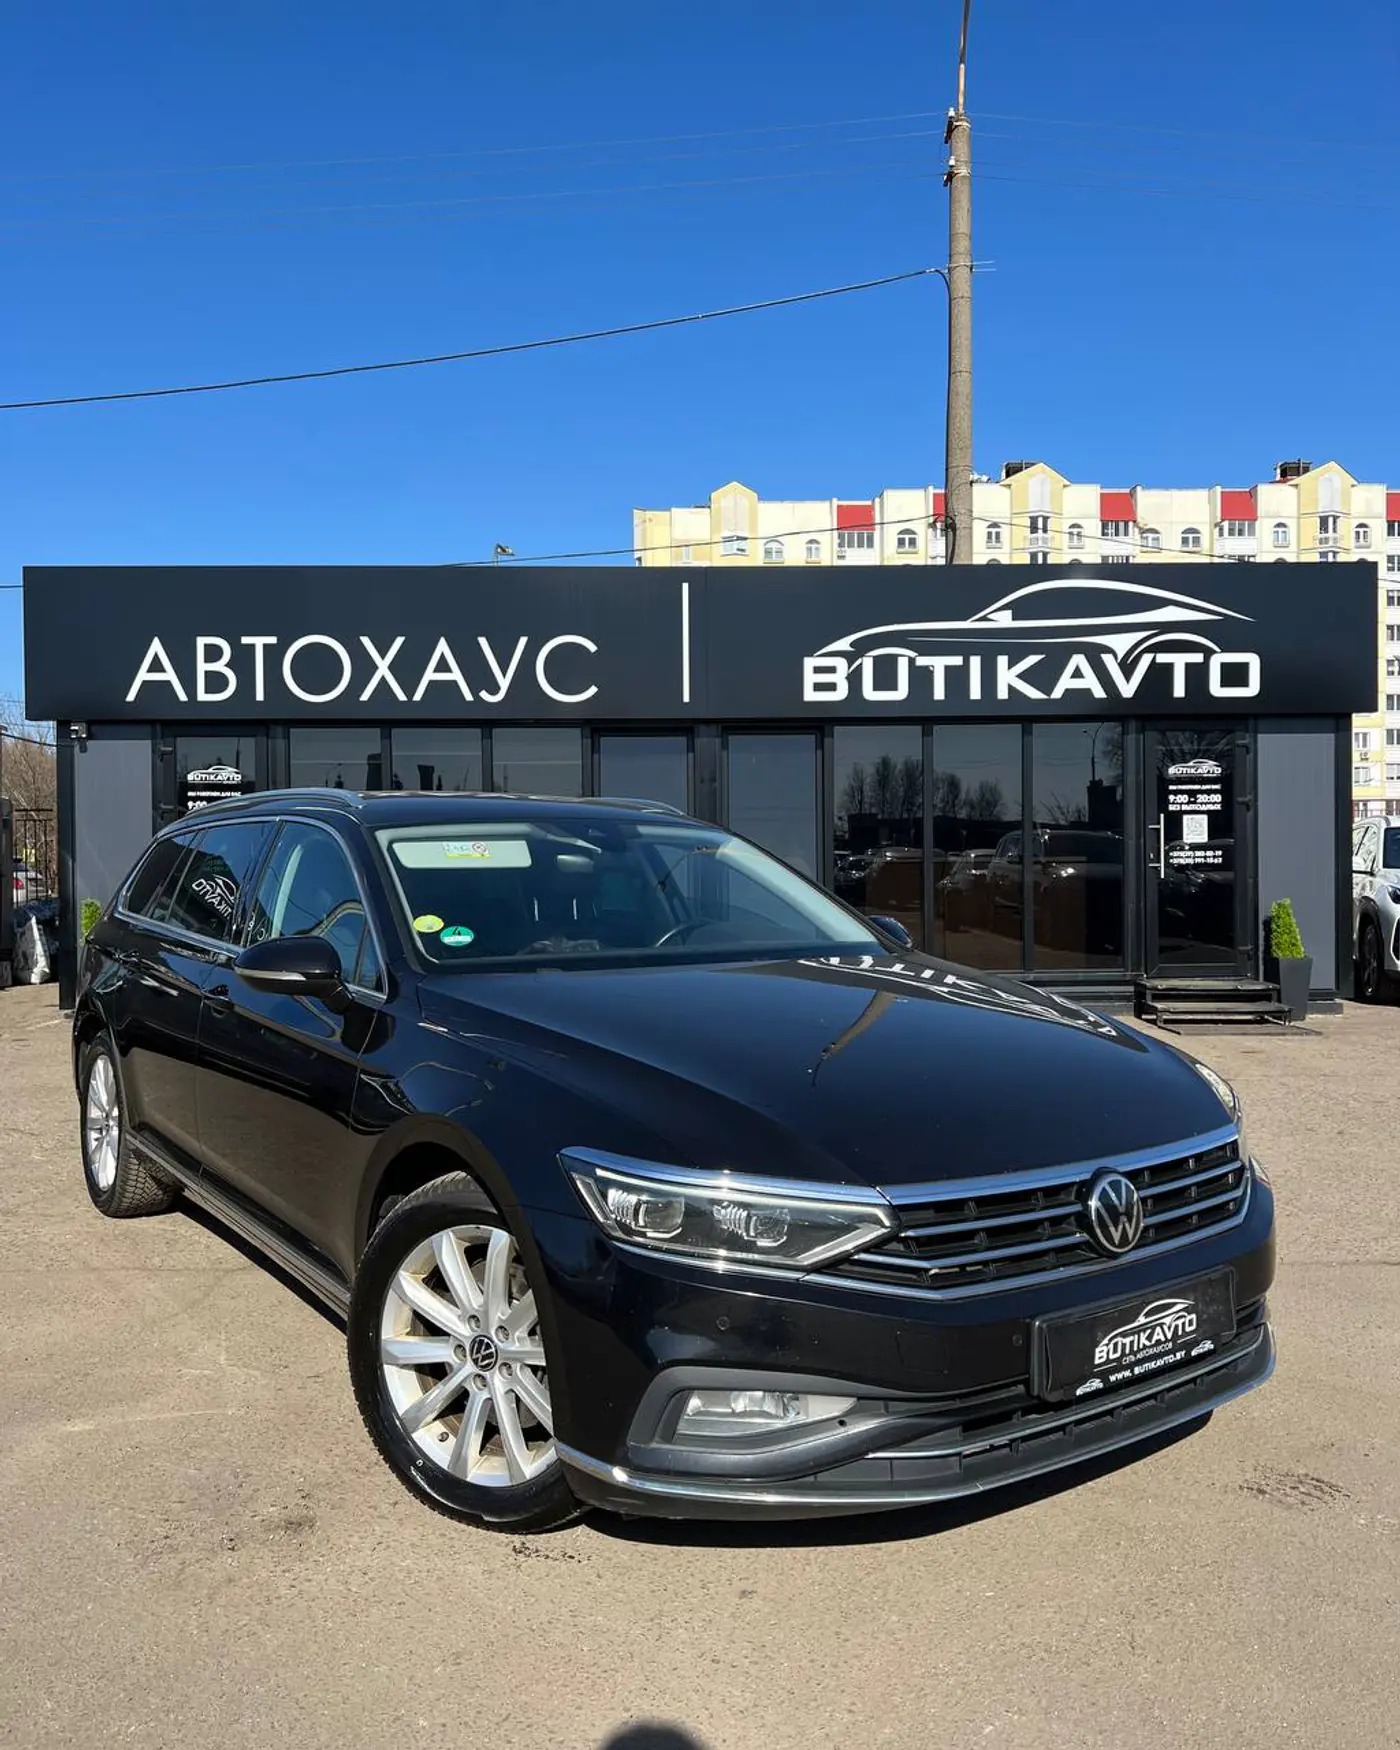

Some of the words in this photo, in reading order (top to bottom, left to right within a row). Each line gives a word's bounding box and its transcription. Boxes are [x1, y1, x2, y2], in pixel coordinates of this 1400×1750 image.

[125, 634, 600, 704] АВТОХАУС
[803, 652, 1262, 703] BUTIKAVTO
[1168, 794, 1189, 803] 9:00
[1196, 794, 1222, 803] 20:00
[1093, 1312, 1197, 1364] BUTIKAVTO
